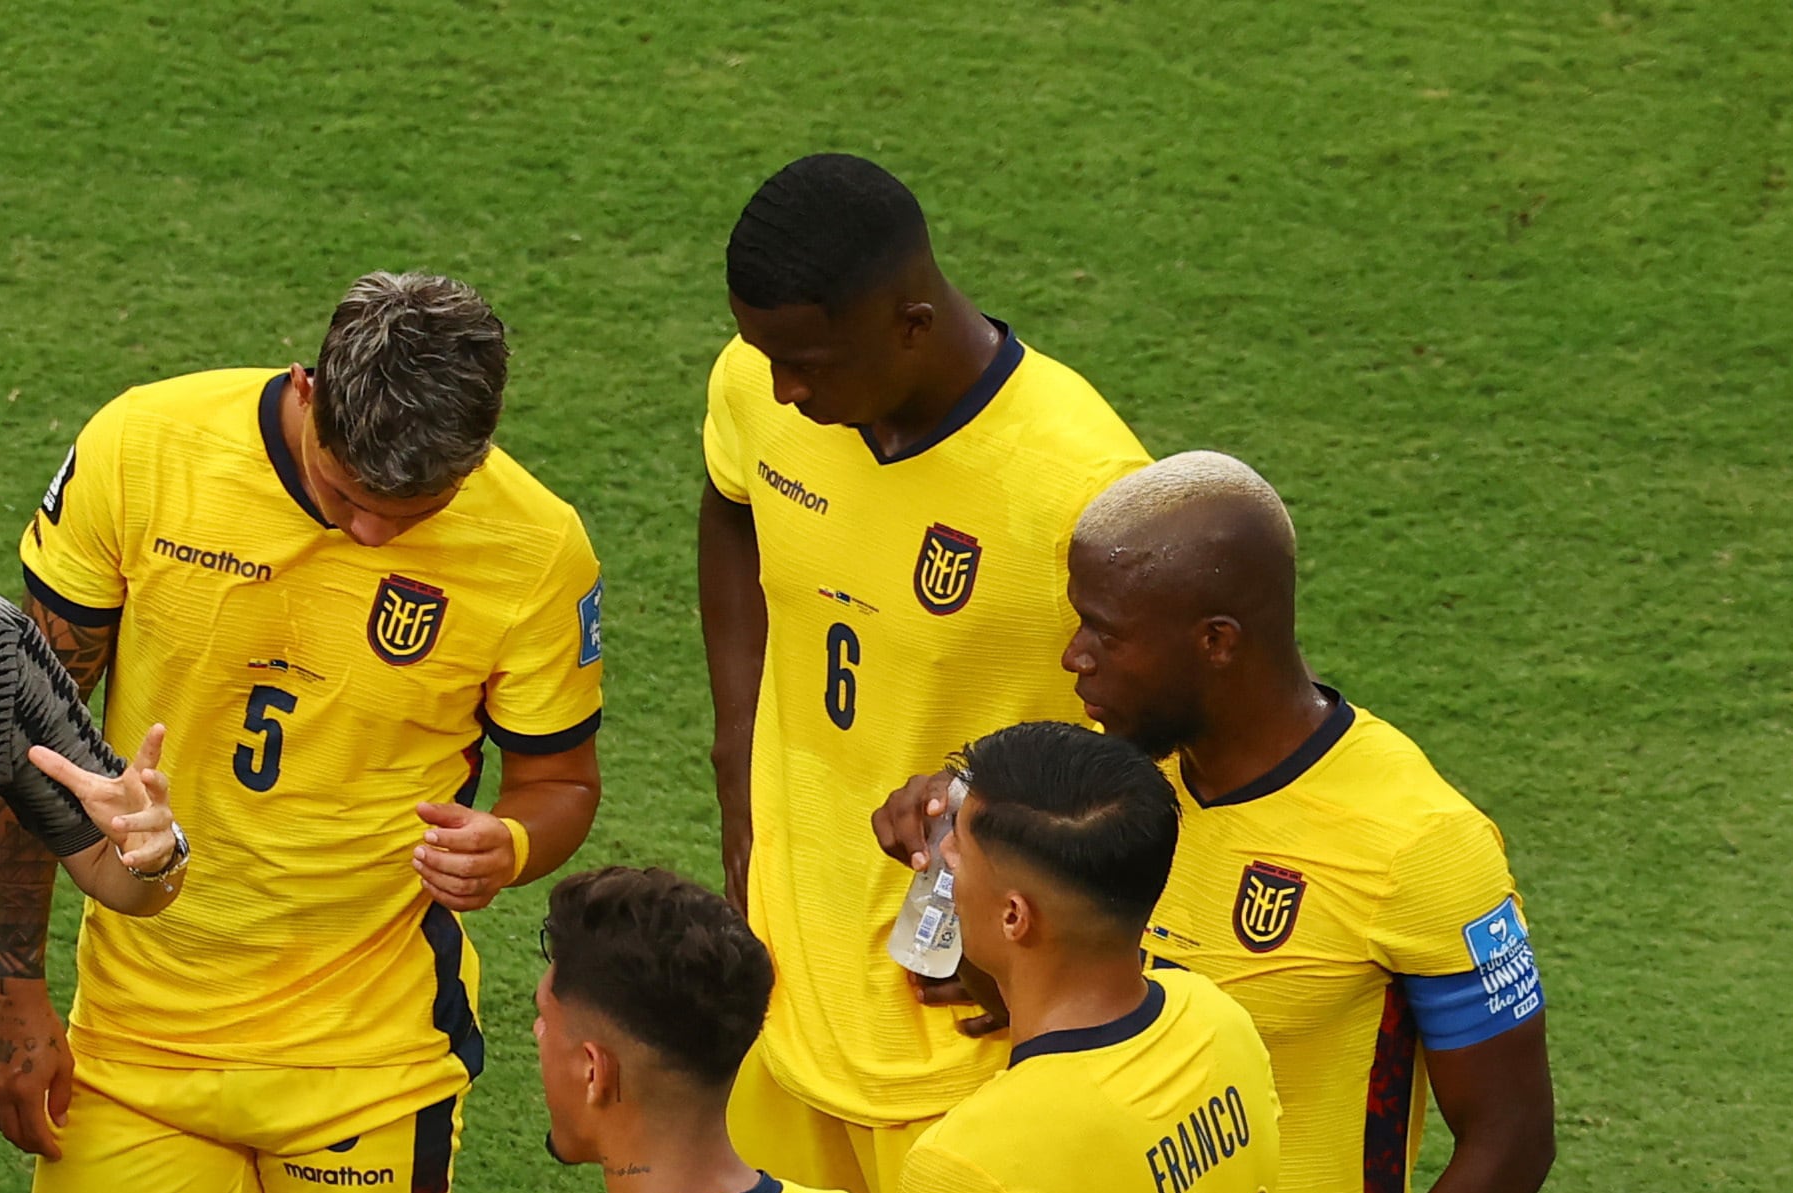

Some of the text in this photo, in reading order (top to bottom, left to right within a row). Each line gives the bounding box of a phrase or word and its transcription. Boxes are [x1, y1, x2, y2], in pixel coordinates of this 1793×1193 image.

[757, 460, 829, 516] marathon
[153, 537, 272, 582] marathon
[824, 622, 861, 731] 6
[233, 685, 299, 793] 5
[284, 1161, 394, 1186] marathon
